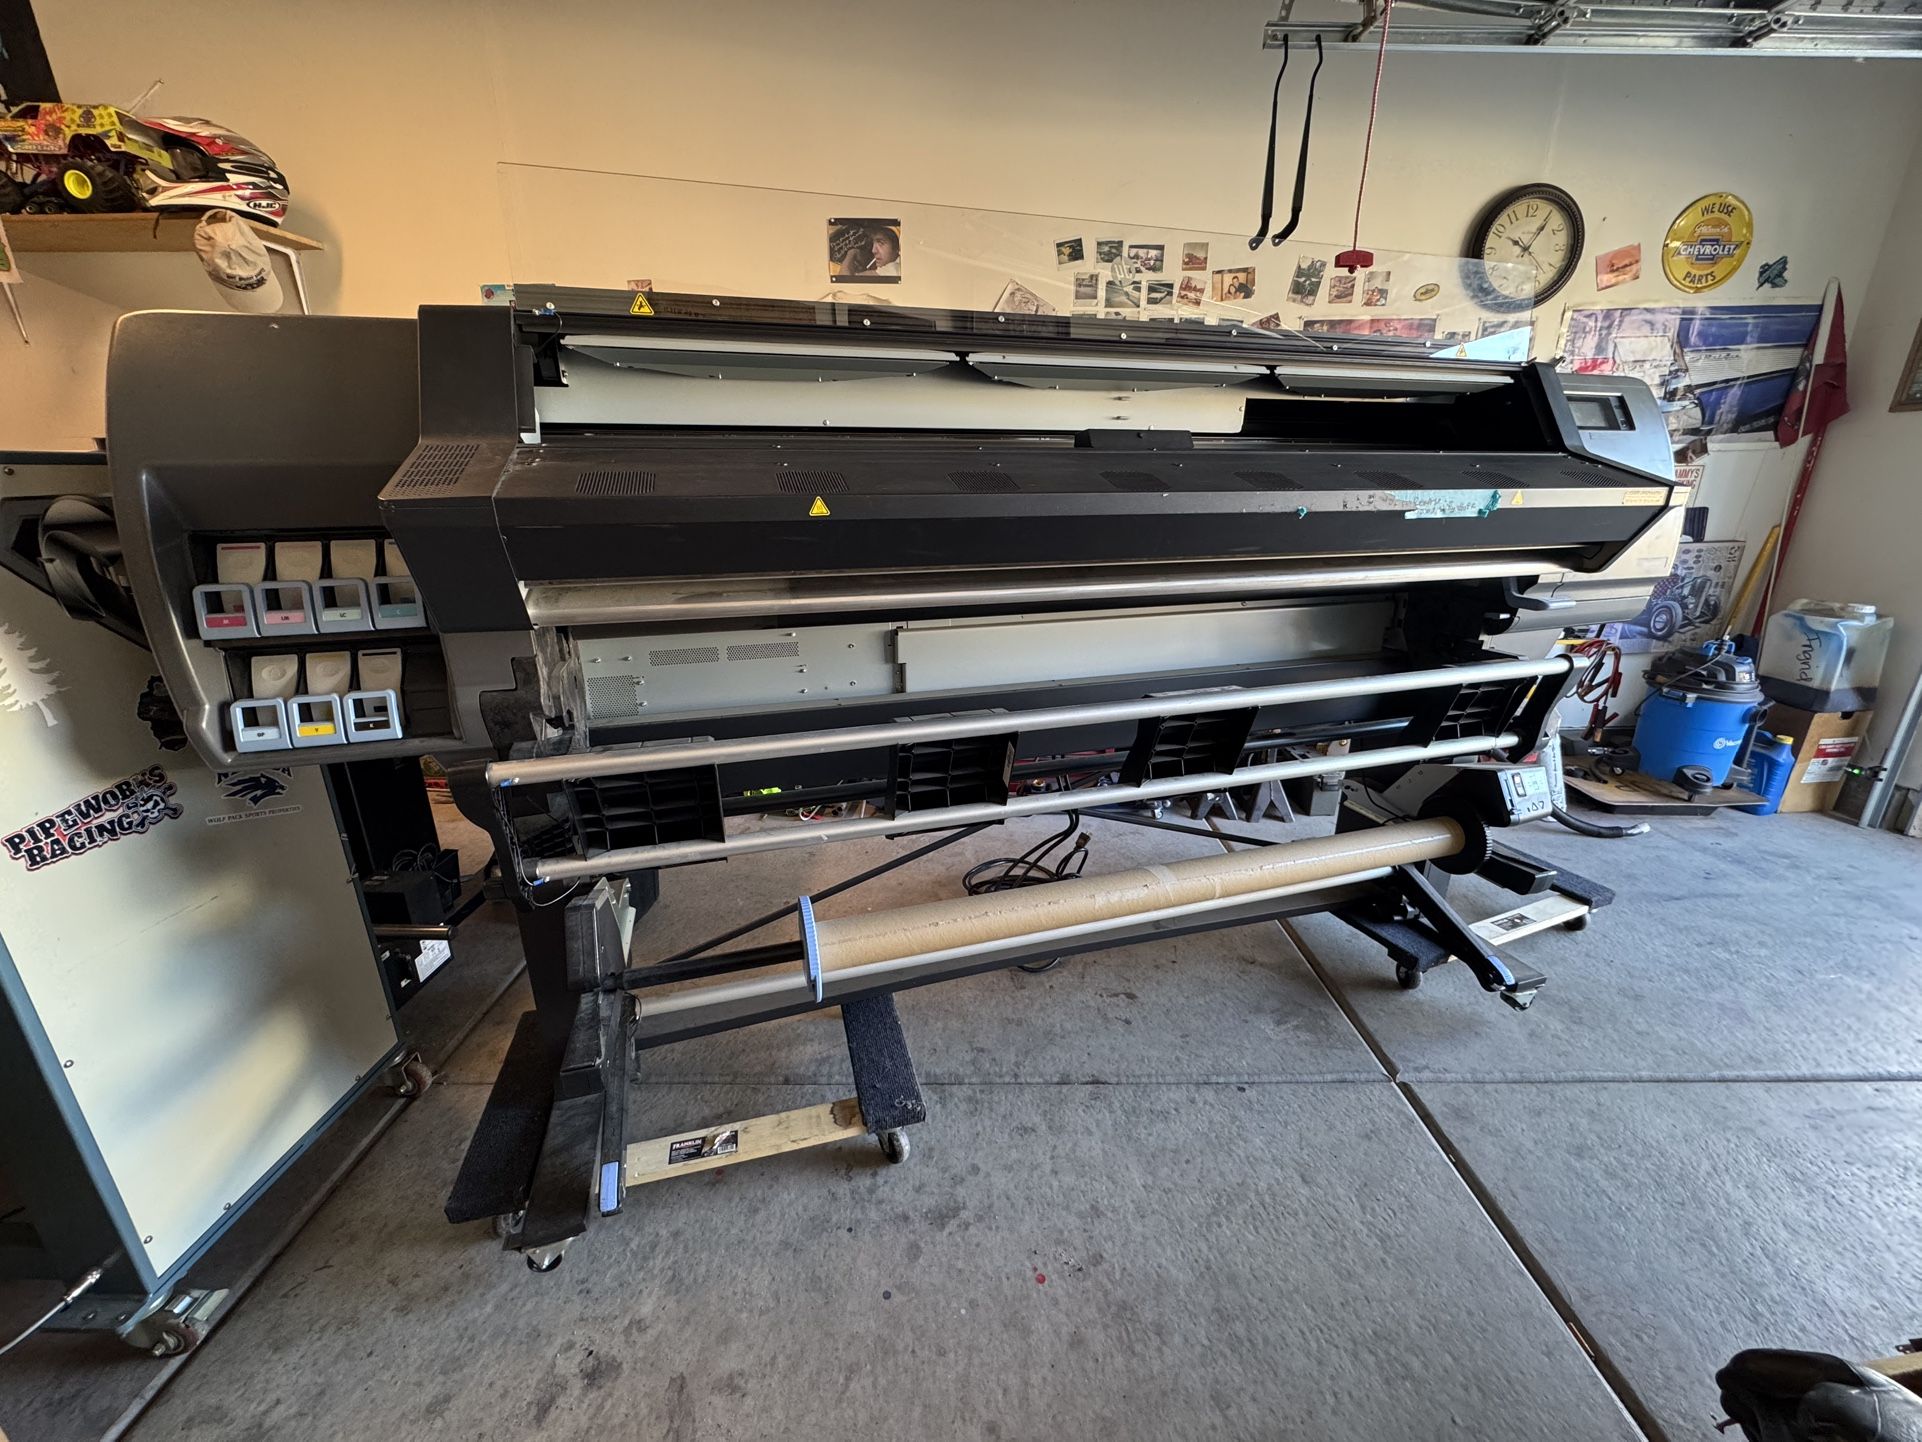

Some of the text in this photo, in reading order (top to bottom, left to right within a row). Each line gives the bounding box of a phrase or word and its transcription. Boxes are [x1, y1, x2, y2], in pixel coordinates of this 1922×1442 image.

[1524, 204, 1539, 218] 12
[1700, 202, 1737, 218] WE USE
[1506, 210, 1519, 225] 11
[1492, 223, 1506, 239] 10
[1552, 223, 1565, 236] 2
[1485, 246, 1497, 256] 9
[1679, 244, 1737, 256] CHEVROLET
[1682, 271, 1717, 286] PARTS
[4, 765, 166, 856] PIPEWORKS
[208, 815, 226, 824] WOLF
[244, 810, 267, 819] SPORTS
[24, 812, 134, 868] RACING
[672, 1139, 702, 1150] FRANKLIN
